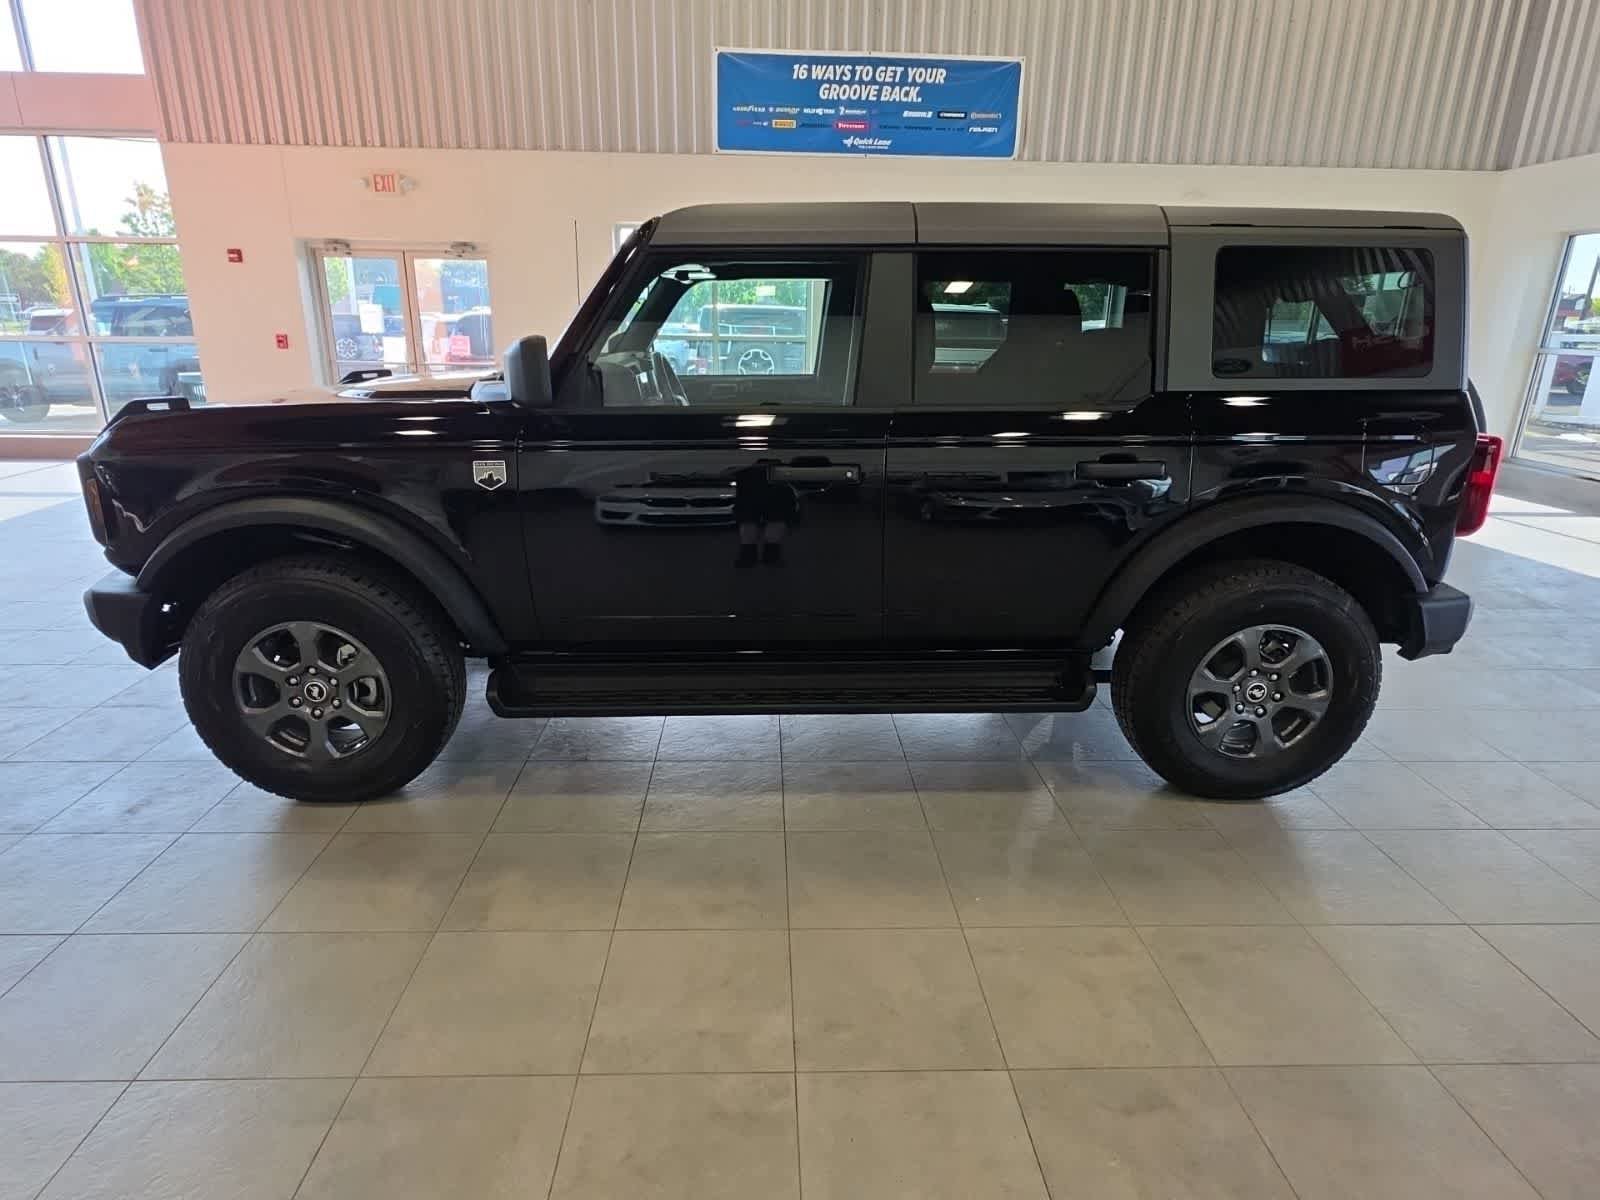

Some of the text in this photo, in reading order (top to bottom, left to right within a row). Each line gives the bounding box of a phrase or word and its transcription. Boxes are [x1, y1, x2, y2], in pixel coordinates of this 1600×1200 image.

[792, 63, 947, 84] 16 WAYS TO GET YOUR
[819, 83, 922, 103] GROOVE BACK.
[372, 174, 396, 193] EXIT
